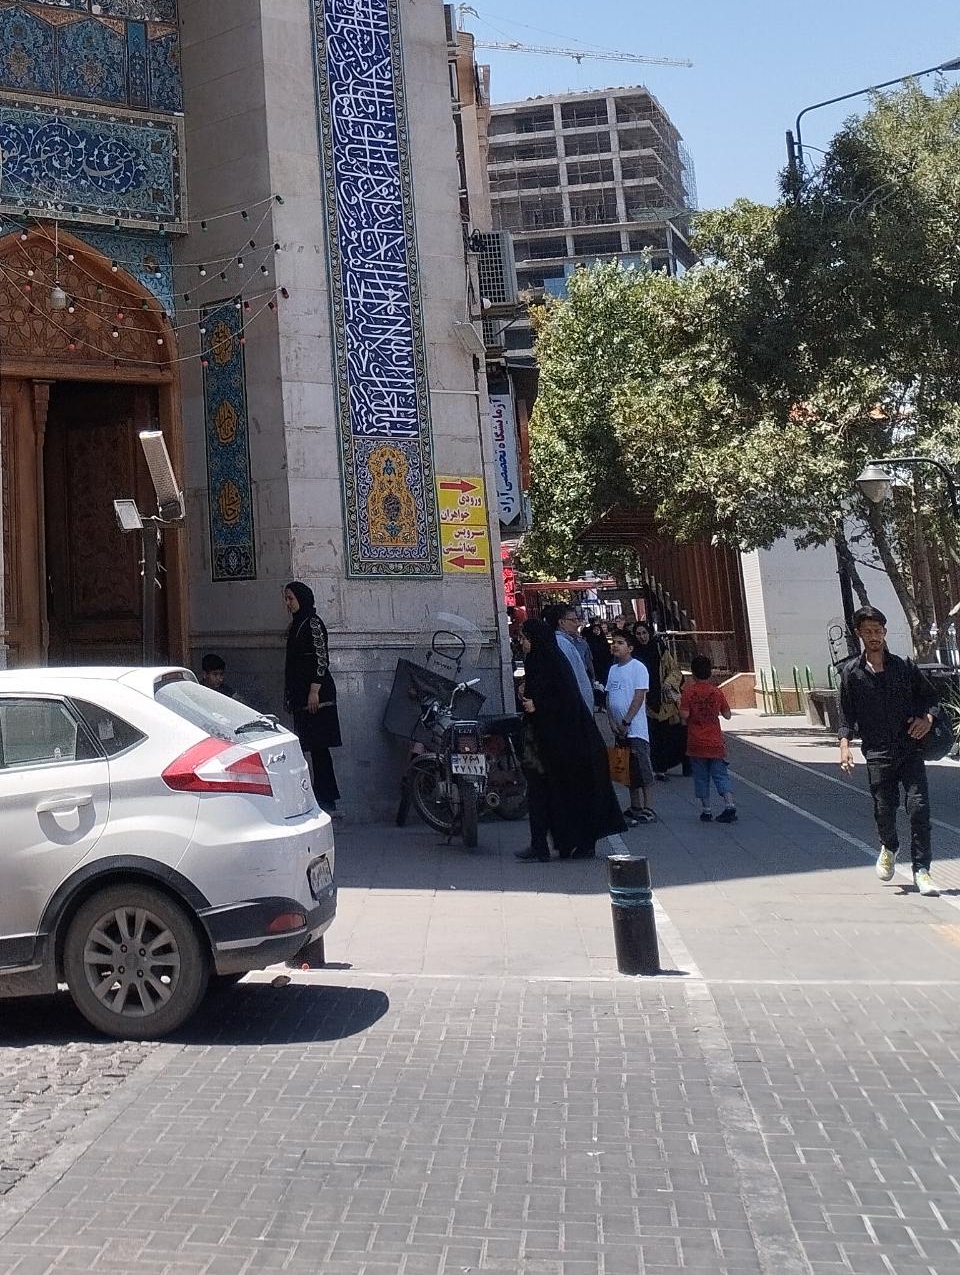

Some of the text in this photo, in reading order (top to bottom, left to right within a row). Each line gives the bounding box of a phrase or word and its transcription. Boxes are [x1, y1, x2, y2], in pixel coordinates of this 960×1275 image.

[489, 397, 509, 449] آزمایشگاه
[500, 493, 514, 513] آراد
[458, 494, 482, 506] ورودی
[441, 510, 470, 523] خواهران
[454, 528, 485, 538] سرویس
[443, 542, 476, 554] بهداشتی
